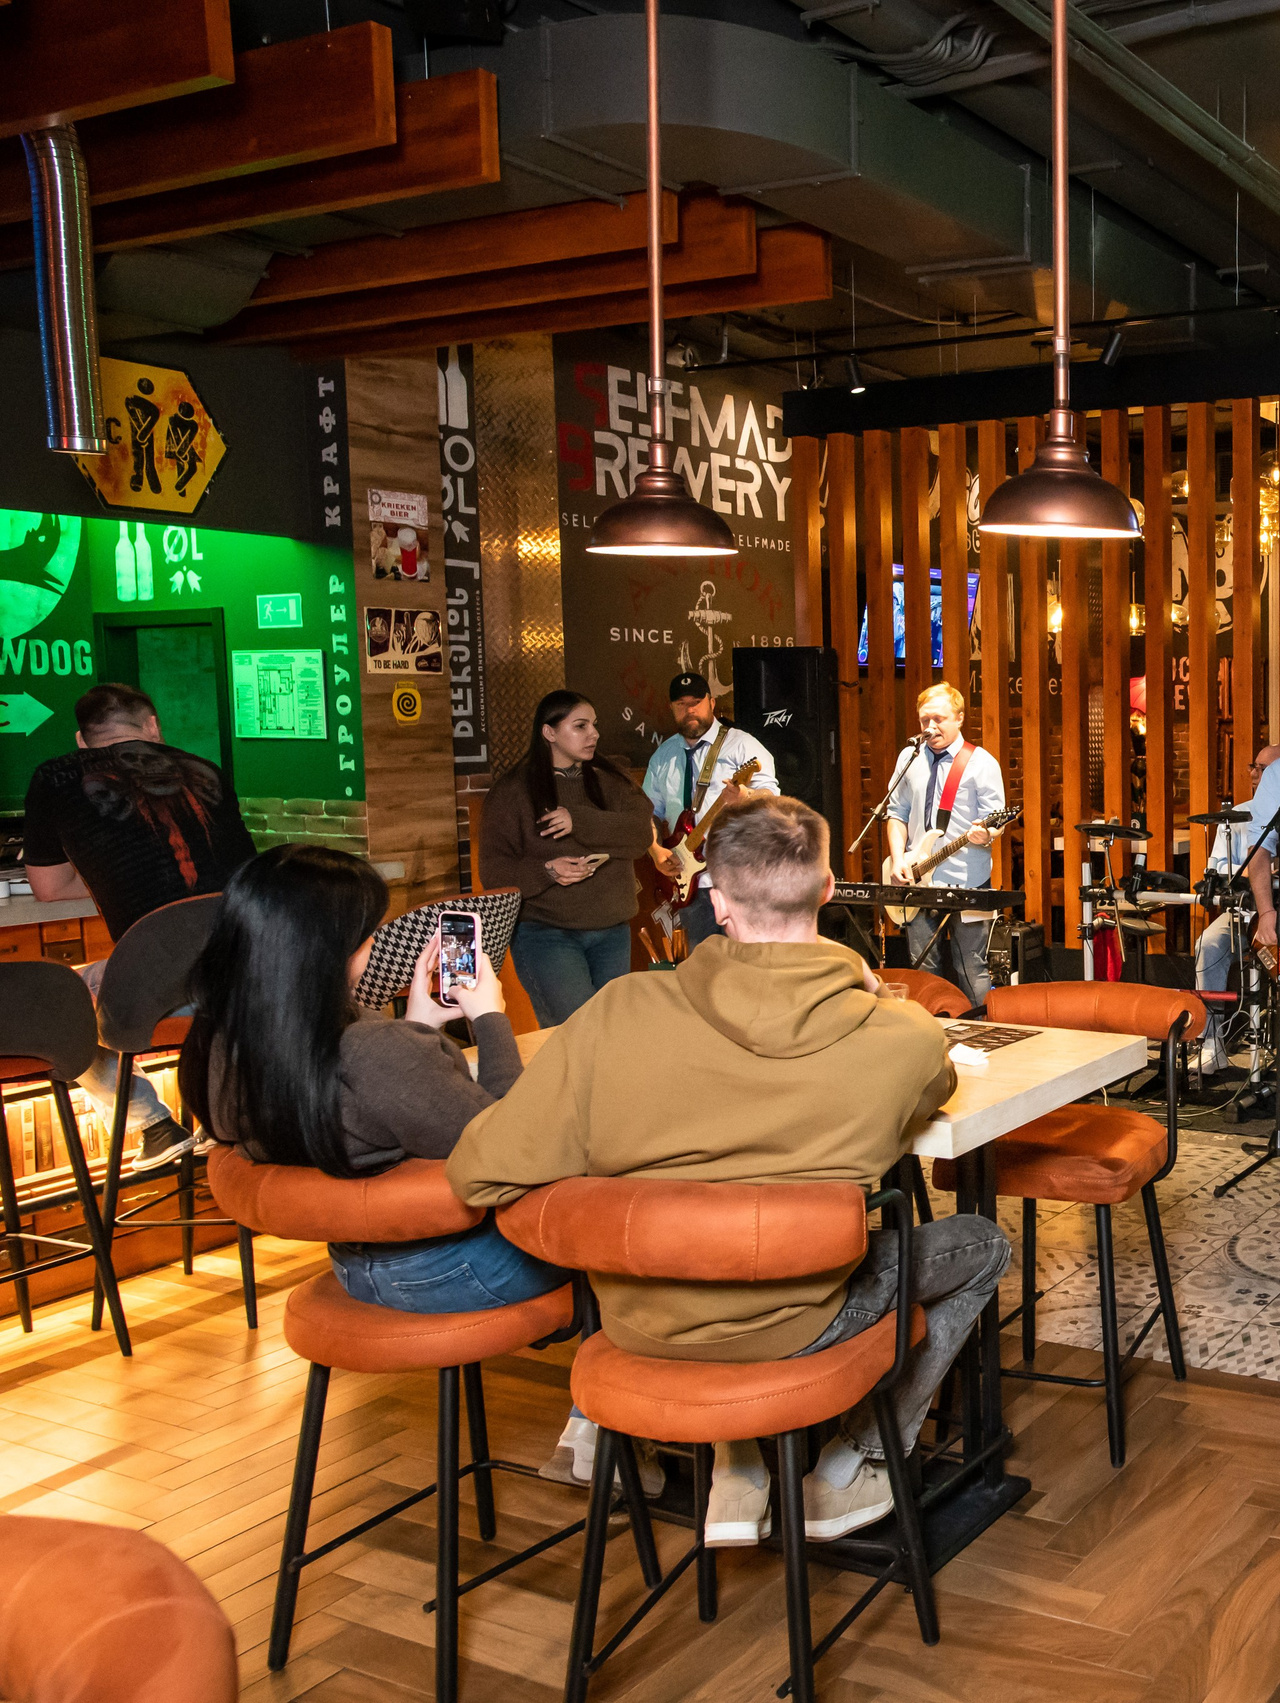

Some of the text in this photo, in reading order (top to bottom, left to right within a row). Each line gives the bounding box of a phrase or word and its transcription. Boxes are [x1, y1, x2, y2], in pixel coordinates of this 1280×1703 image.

[318, 376, 342, 527] КРАФТ
[381, 502, 417, 511] KRIEKEN
[733, 533, 791, 552] ELFMADE
[610, 627, 674, 644] SINCE
[751, 634, 795, 648] 1896
[328, 573, 356, 772] ГРОУЛЕР
[373, 659, 382, 669] TO
[383, 660, 391, 669] BE
[392, 660, 409, 670] HARD
[621, 706, 664, 747] SAN
